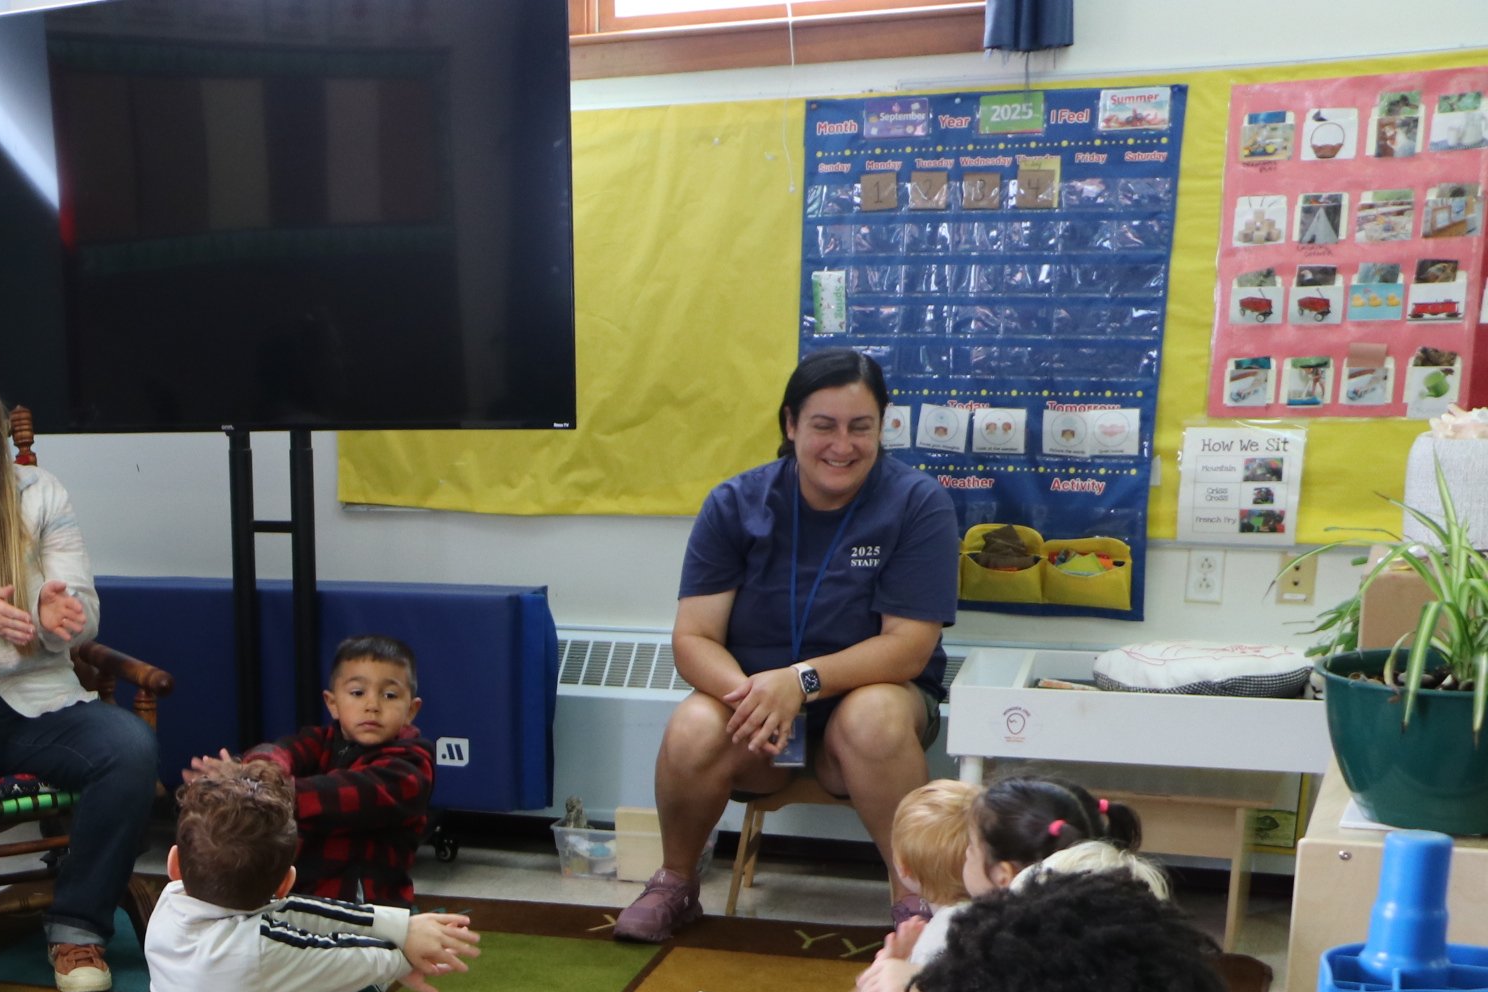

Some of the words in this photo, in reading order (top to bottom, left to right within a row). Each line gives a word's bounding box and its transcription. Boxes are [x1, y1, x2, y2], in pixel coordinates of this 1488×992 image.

[1111, 93, 1159, 105] Summer
[880, 112, 926, 122] September
[991, 103, 1033, 122] 2025
[1050, 110, 1057, 124] I
[1058, 108, 1090, 124] Feel
[817, 120, 858, 135] Month
[939, 115, 970, 128] Year
[960, 156, 1012, 167] Wednesday
[1075, 153, 1107, 164] Friday
[1125, 151, 1167, 161] Saturday
[818, 163, 851, 173] Sunday
[866, 160, 902, 171] Monday
[915, 158, 954, 168] Tuesday
[874, 180, 883, 203] 1
[1027, 178, 1040, 199] 4
[833, 286, 844, 318] Spring
[1201, 439, 1234, 451] How
[1240, 440, 1259, 451] We
[1265, 438, 1289, 451] Sit
[938, 474, 994, 488] Weather
[1051, 478, 1105, 494] Activity
[1223, 516, 1237, 524] Fry
[851, 546, 881, 557] 2025
[851, 558, 880, 567] STAFF
